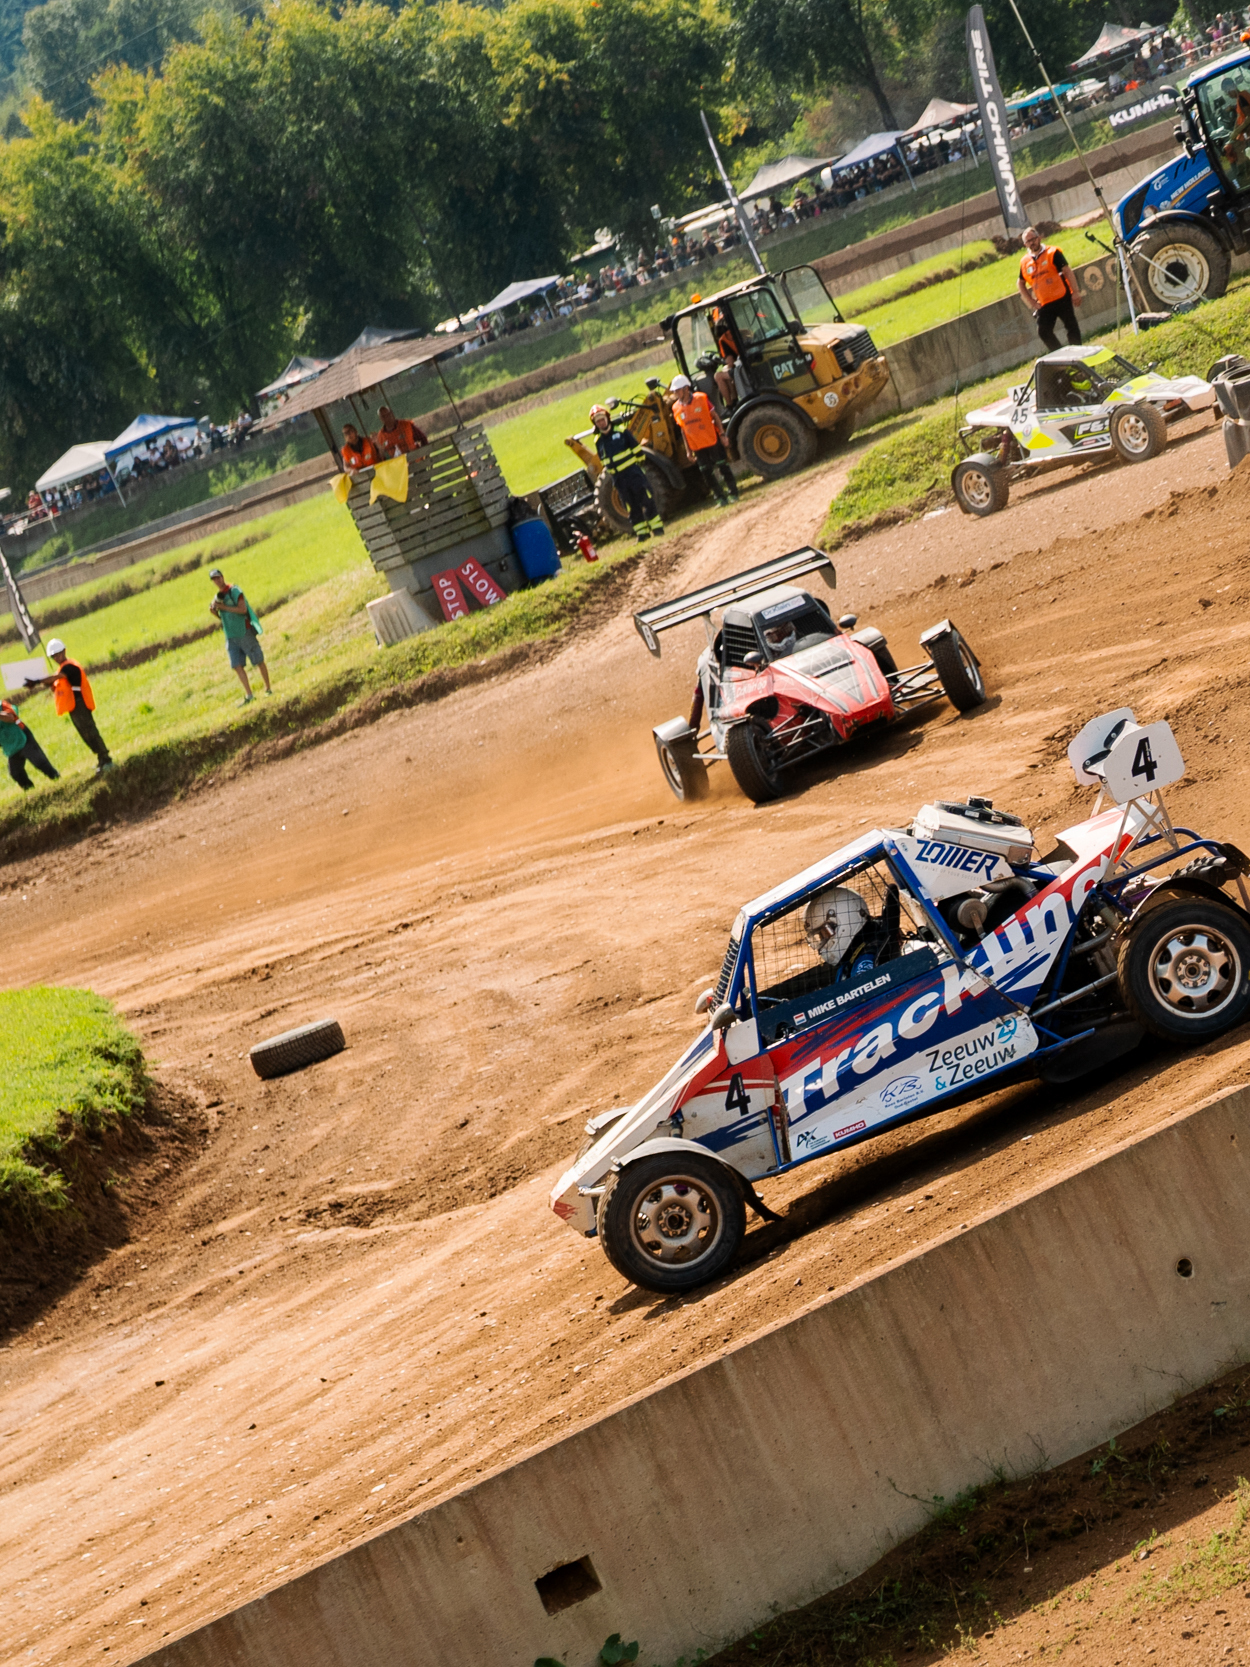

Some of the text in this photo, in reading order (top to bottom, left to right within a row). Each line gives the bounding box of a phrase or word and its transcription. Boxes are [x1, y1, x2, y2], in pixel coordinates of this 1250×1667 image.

[971, 29, 1017, 213] KUMHO TIRE
[1170, 187, 1185, 200] NEW
[1184, 166, 1211, 189] HOLLAND
[773, 360, 795, 380] CAT
[1011, 408, 1028, 425] 45
[438, 578, 464, 620] STOP
[461, 563, 500, 605] SLOW
[1131, 736, 1157, 782] 4
[915, 839, 1000, 881] ZOMER
[807, 973, 892, 1018] MIKE BARTELEN
[925, 1032, 995, 1073] Zeeuw
[935, 1044, 1016, 1091] & Zeeuw
[725, 1072, 751, 1116] 4
[834, 1122, 865, 1138] KUMHO
